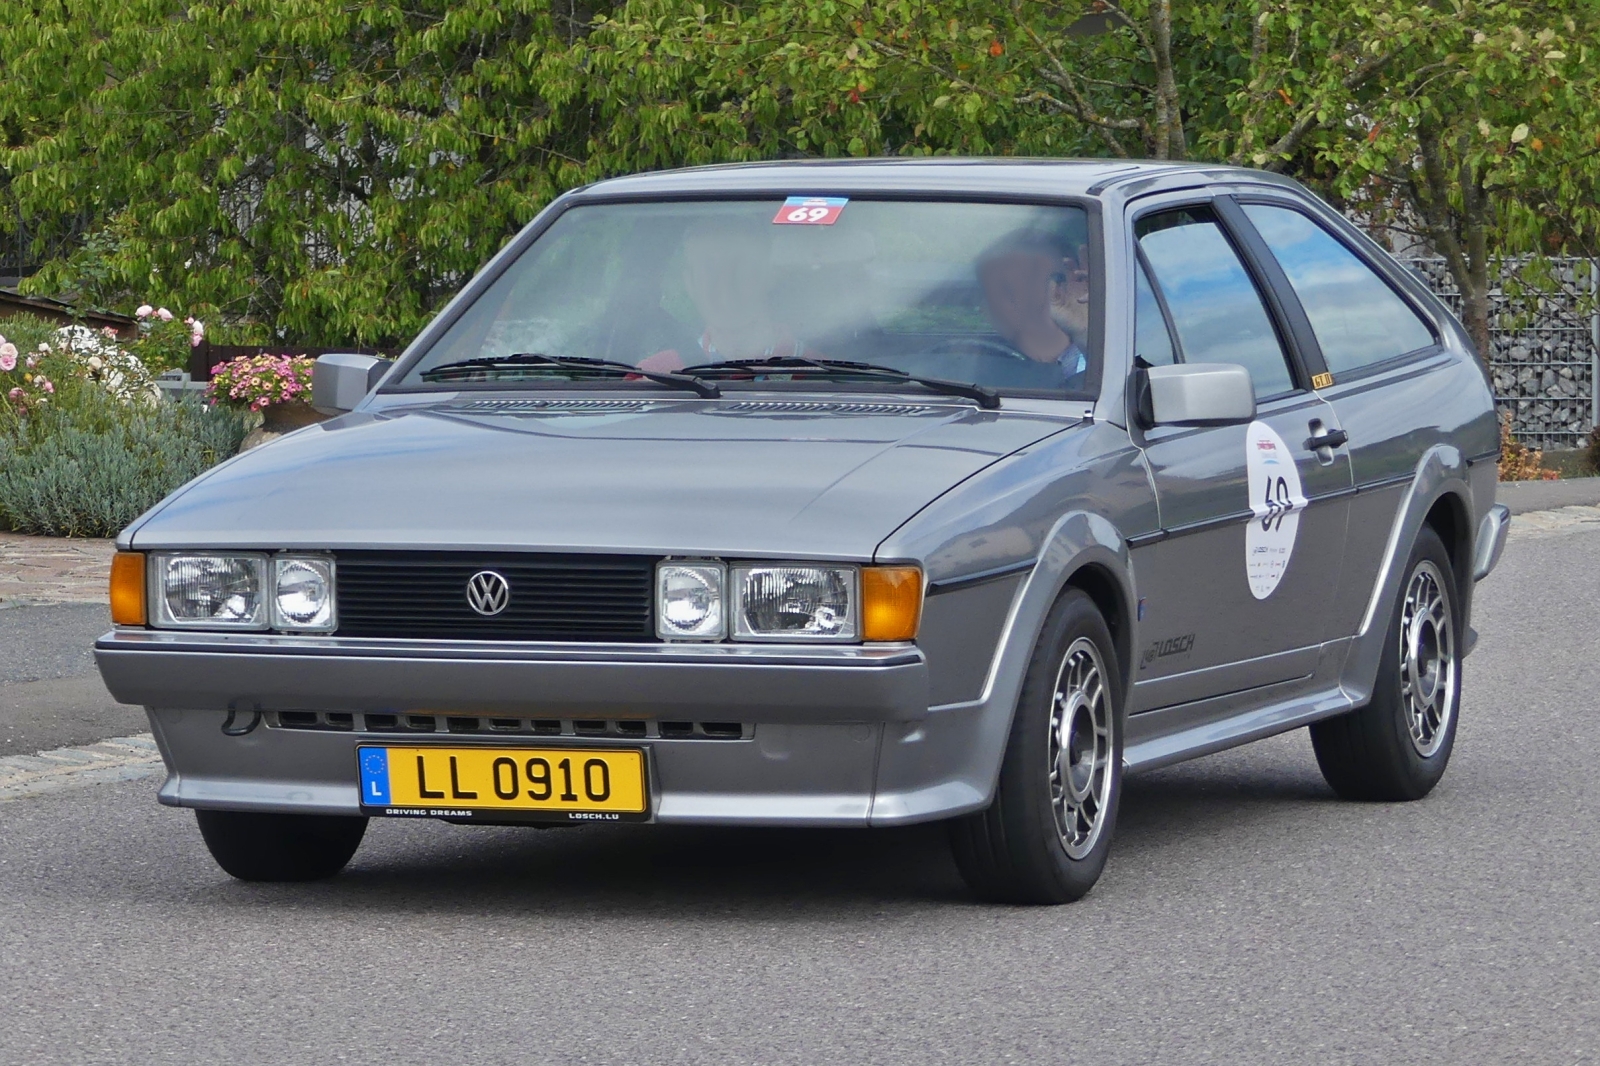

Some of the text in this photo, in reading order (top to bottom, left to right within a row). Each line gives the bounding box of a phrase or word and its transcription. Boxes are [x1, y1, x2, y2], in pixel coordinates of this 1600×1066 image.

[787, 207, 829, 222] 69
[1261, 475, 1293, 533] 69
[467, 571, 509, 615] VW
[1158, 634, 1195, 657] LOSCH
[371, 781, 382, 796] L
[416, 756, 611, 802] LL 0910
[386, 808, 473, 817] DRIVING DREAMS
[568, 812, 619, 820] LOSCH.LU
